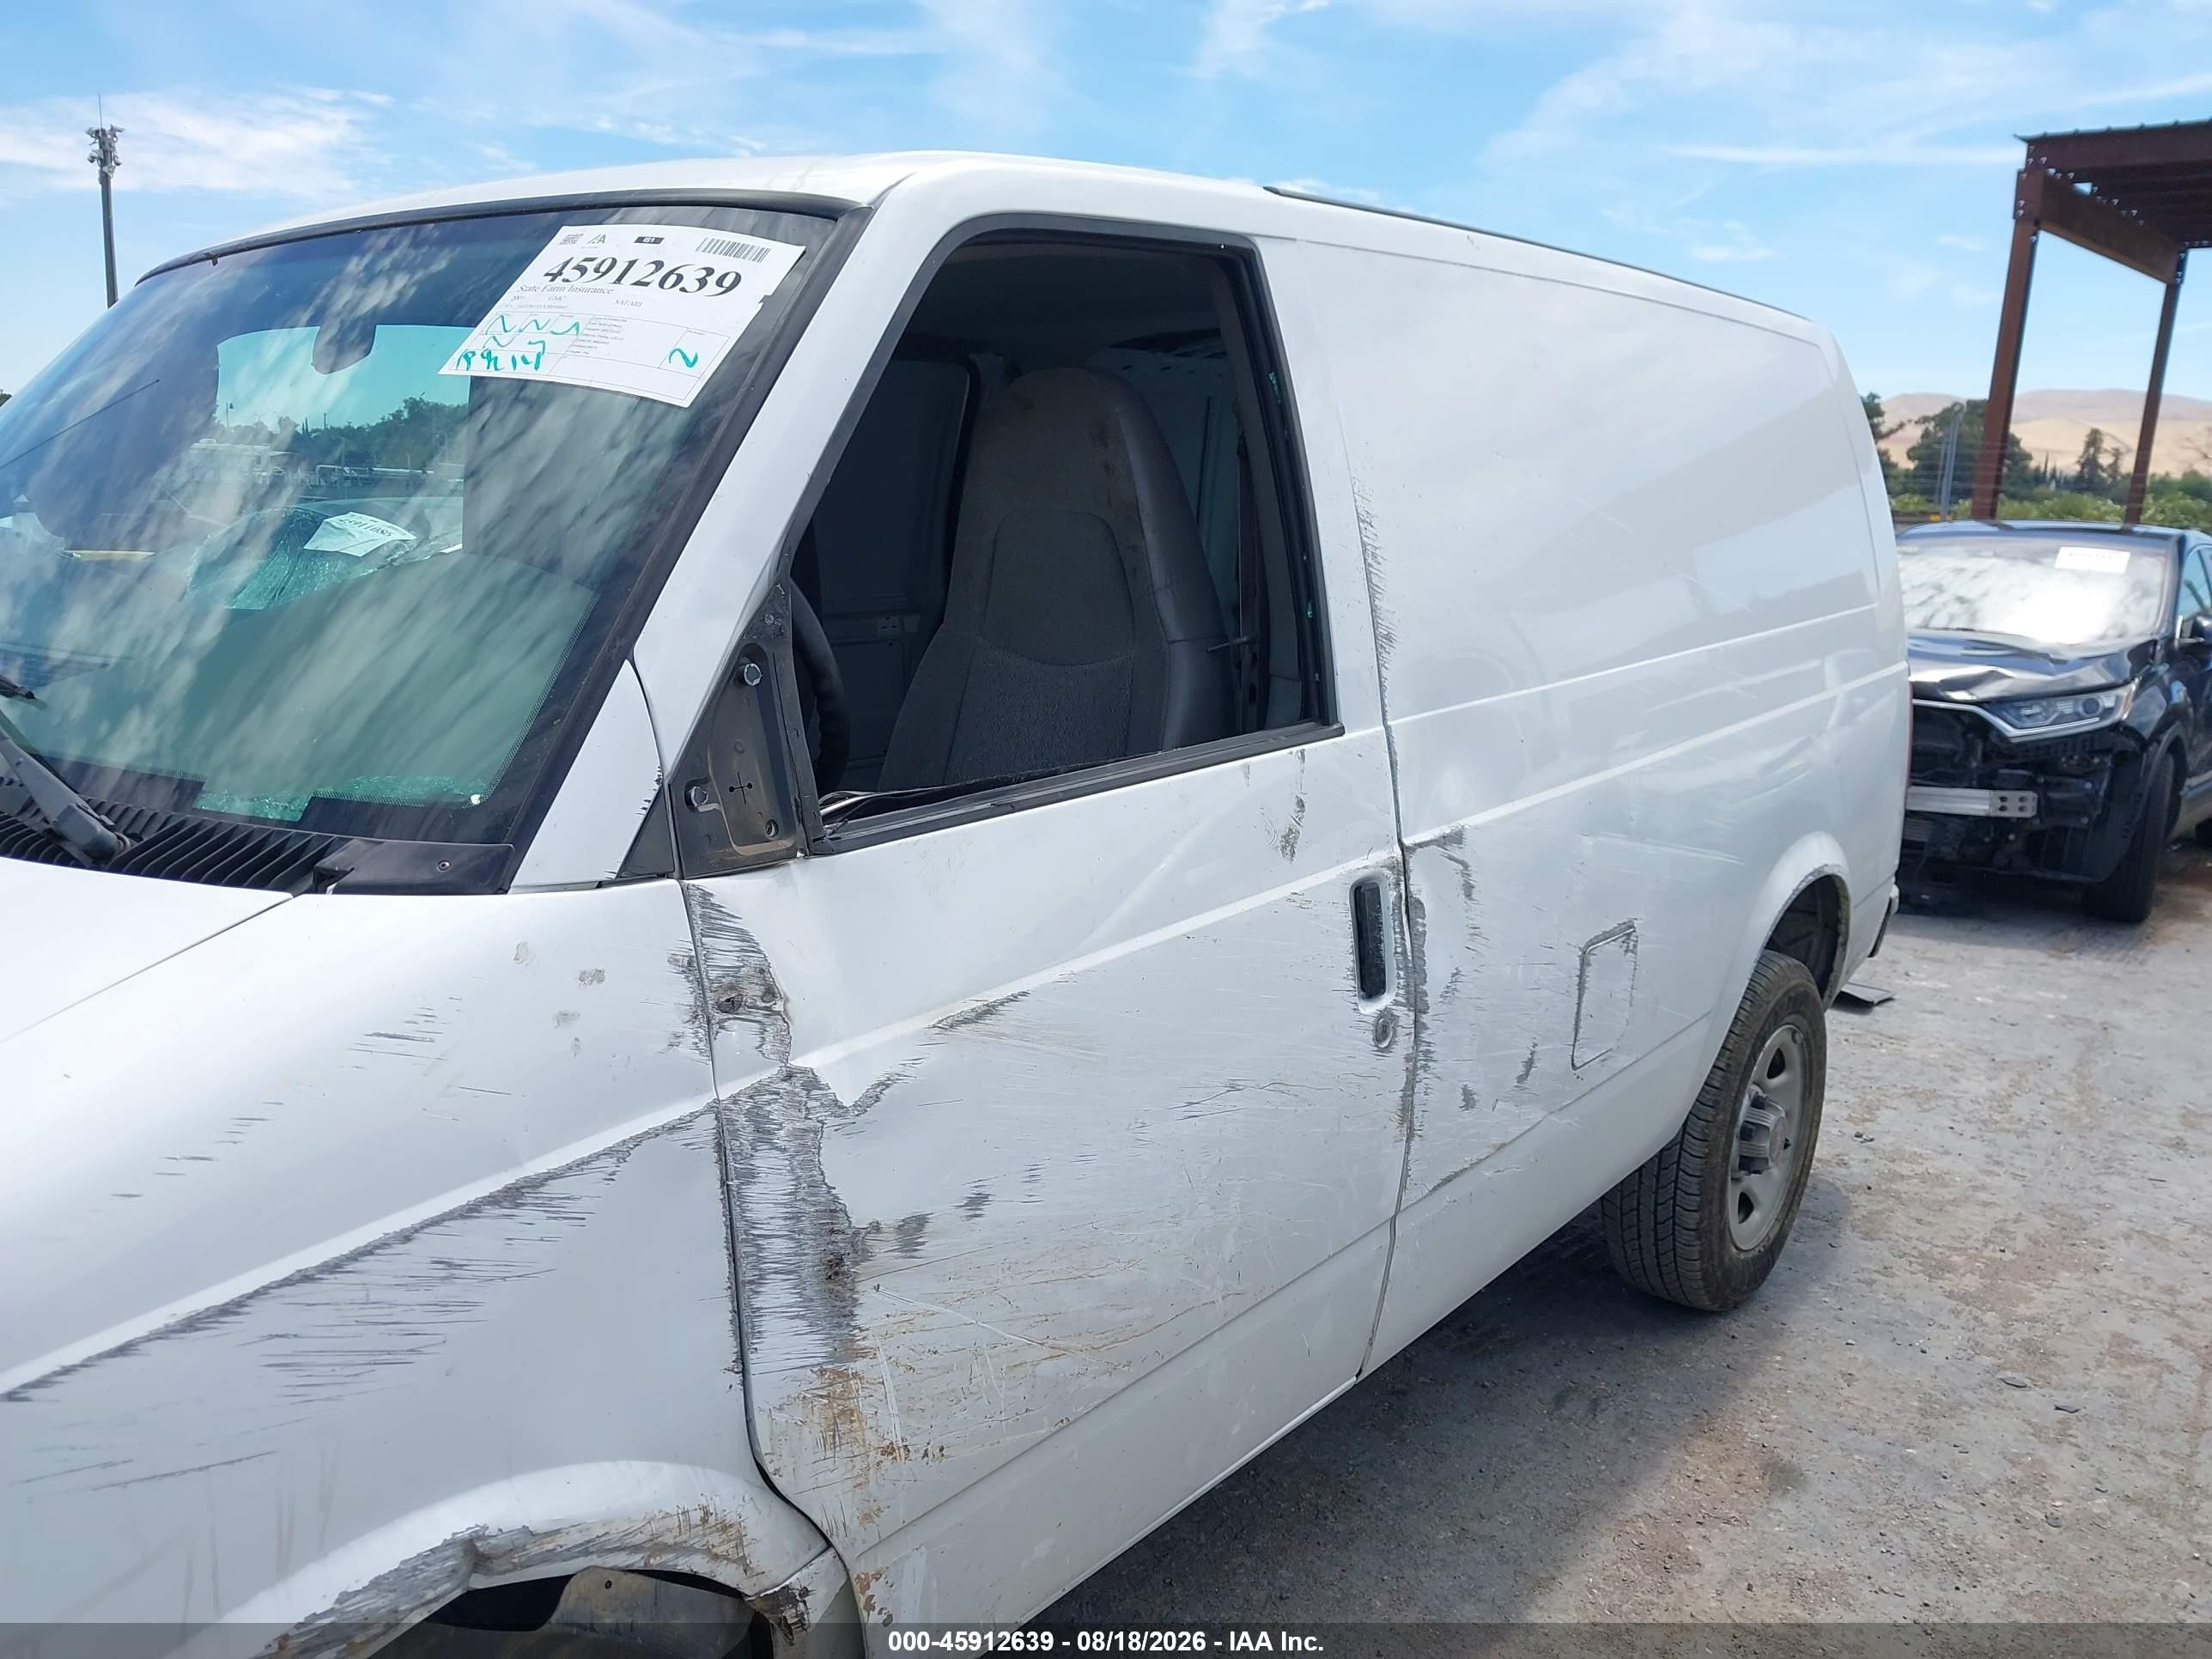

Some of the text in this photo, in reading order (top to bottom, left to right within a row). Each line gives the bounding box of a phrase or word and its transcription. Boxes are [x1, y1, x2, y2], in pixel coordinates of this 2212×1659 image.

[543, 256, 743, 297] 45912639
[518, 284, 614, 295] State Farm Insurance
[615, 299, 643, 308] SAFARI
